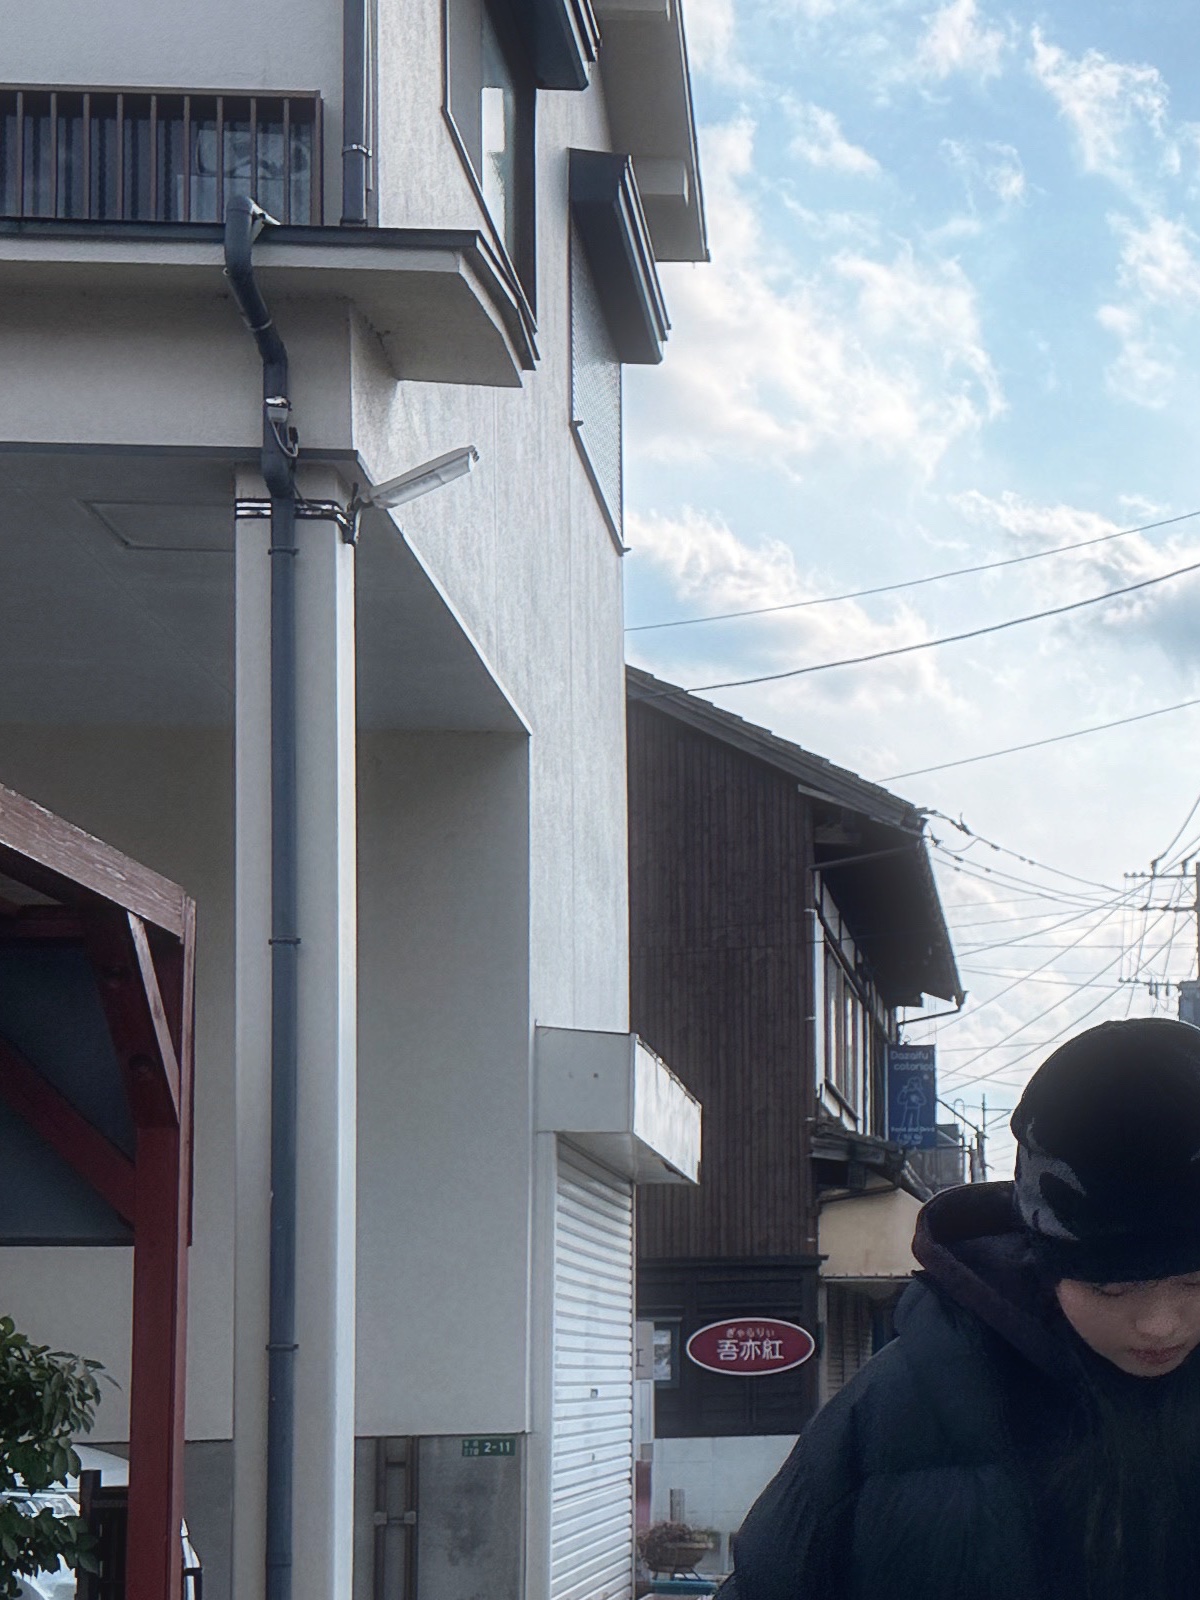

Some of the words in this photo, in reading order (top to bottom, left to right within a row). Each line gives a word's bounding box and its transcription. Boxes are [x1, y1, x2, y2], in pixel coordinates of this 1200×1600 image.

[890, 1050, 929, 1060] Dazaifu
[717, 1339, 784, 1361] 吾亦紅
[484, 1442, 509, 1453] 2-11
